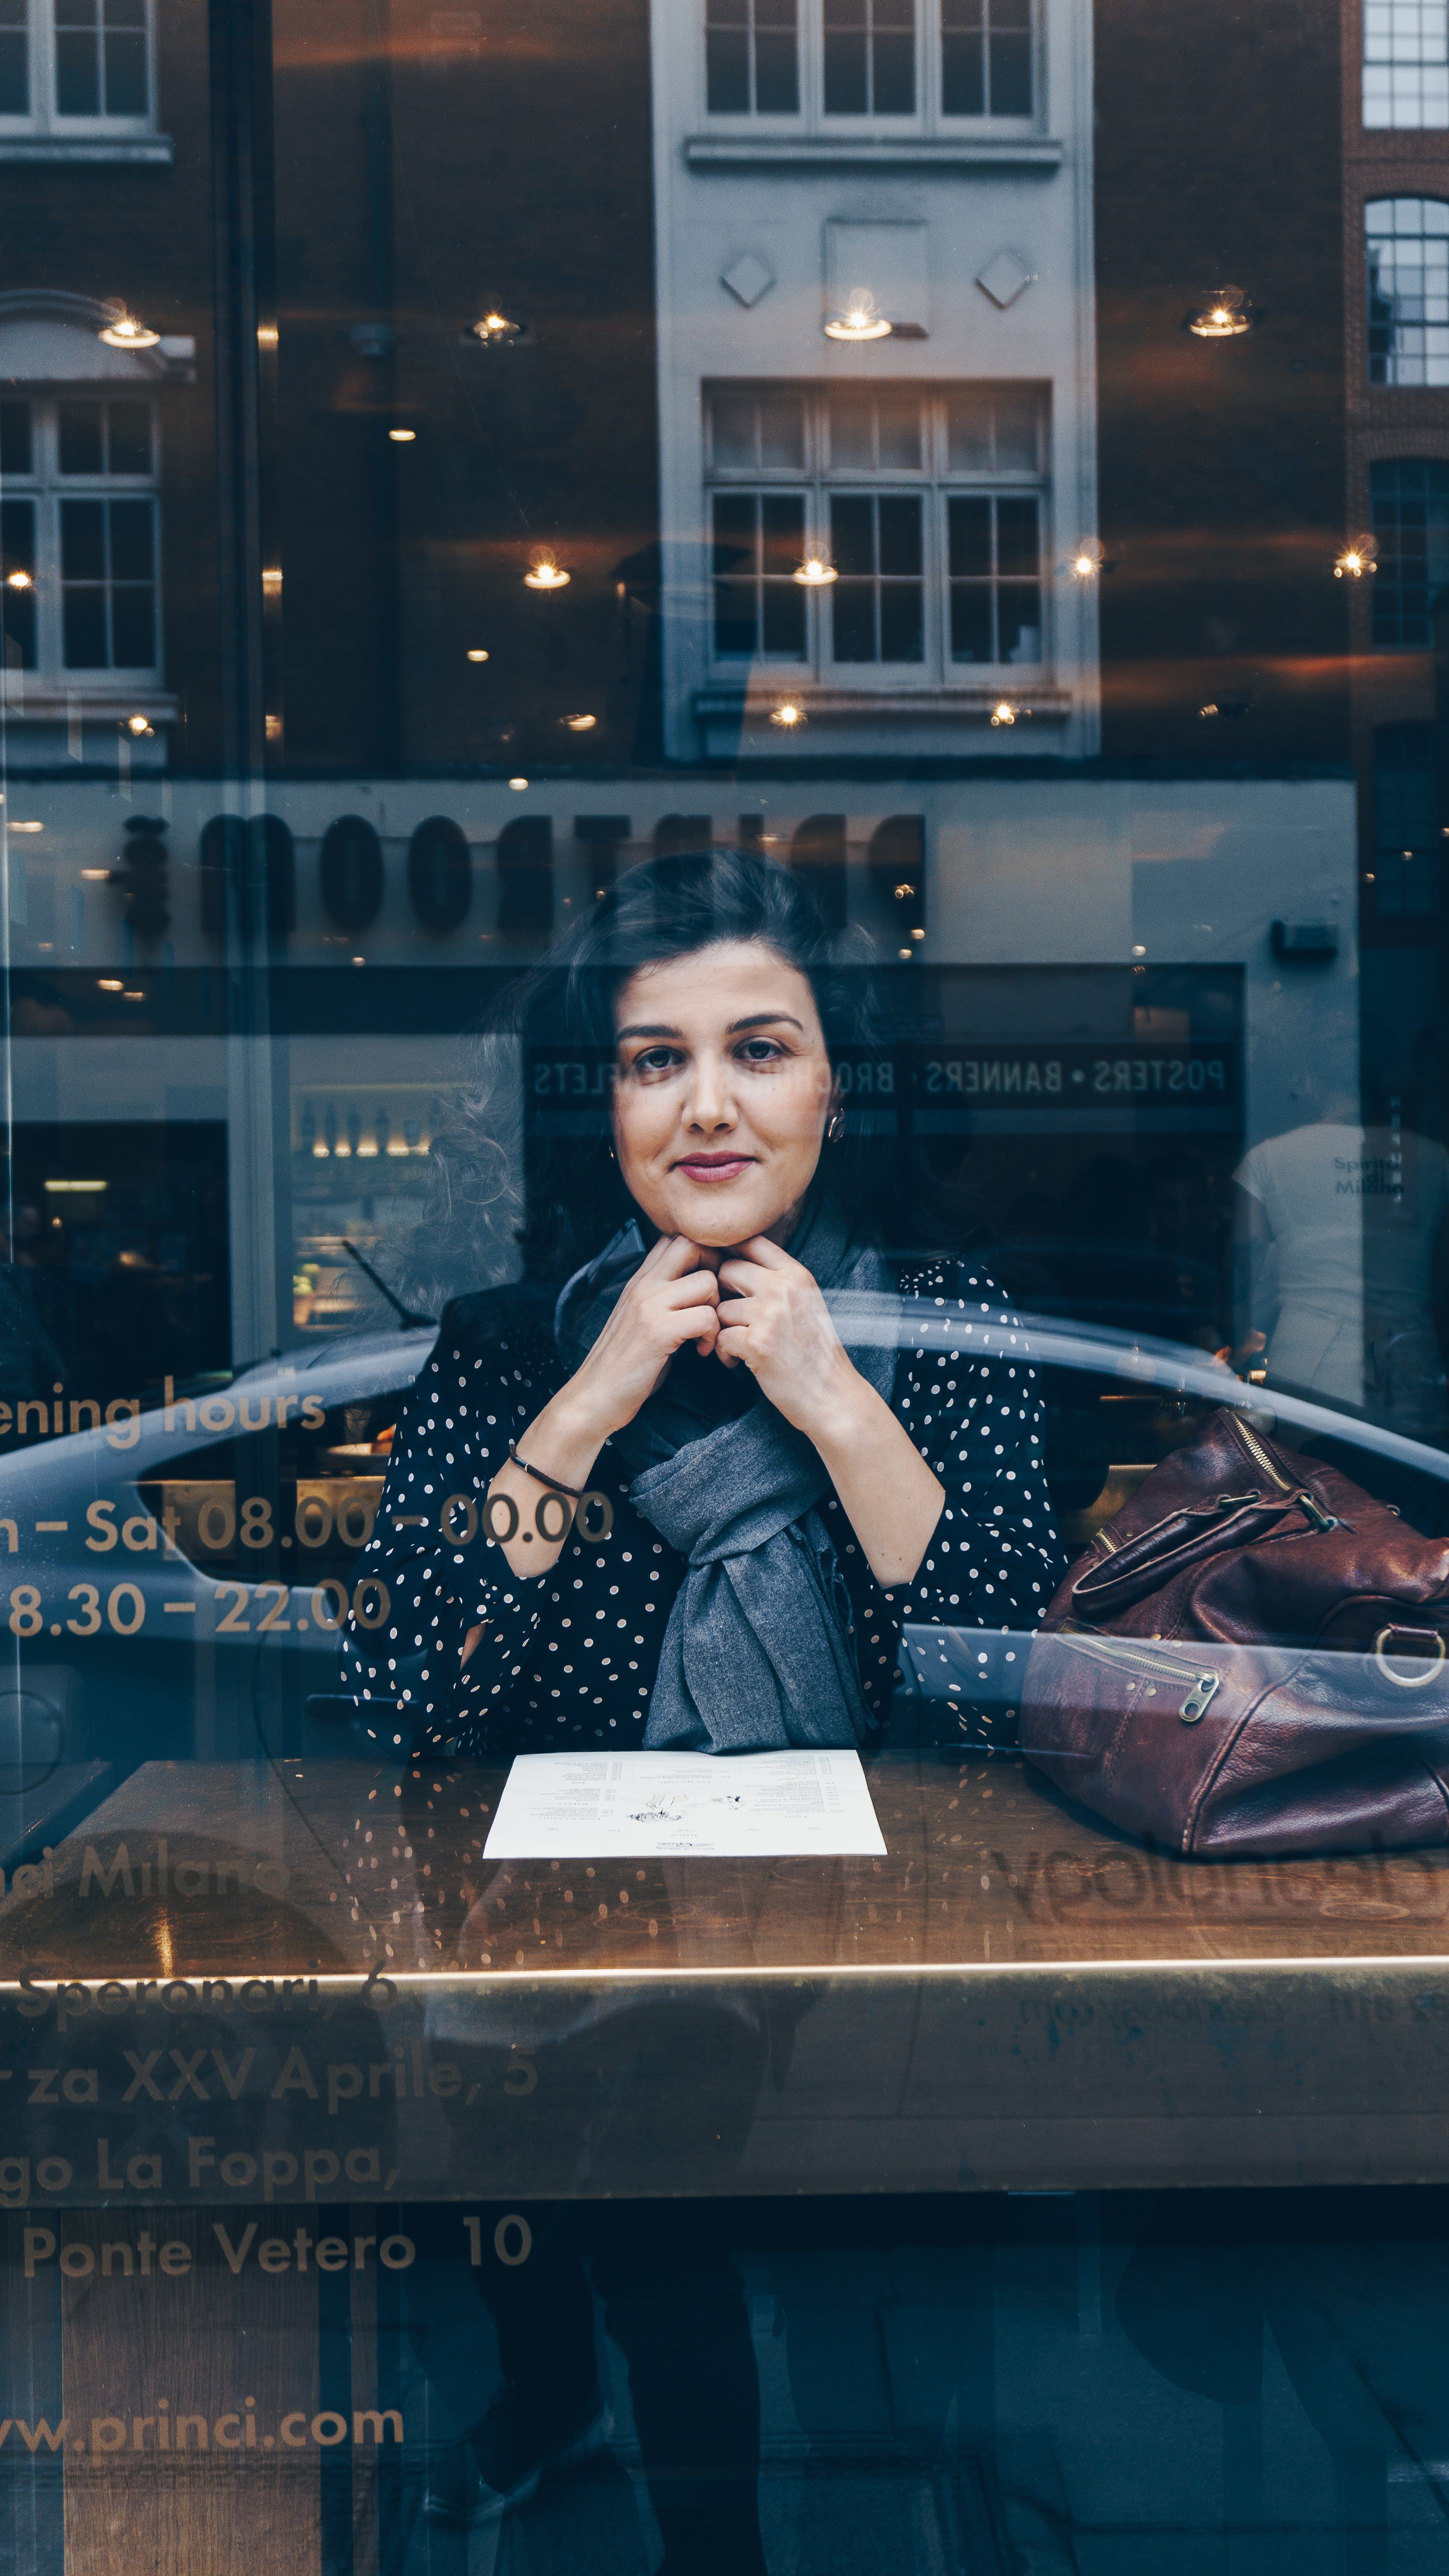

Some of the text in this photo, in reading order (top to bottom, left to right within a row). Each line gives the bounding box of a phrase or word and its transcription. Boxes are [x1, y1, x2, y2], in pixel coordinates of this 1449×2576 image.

[1336, 1179, 1405, 1194] Milano
[1368, 1170, 1385, 1182] di
[164, 1375, 326, 1433] hours
[85, 1500, 181, 1552] Sat
[197, 1496, 376, 1549] 08.00
[440, 1490, 614, 1546] 00.00
[9, 1583, 146, 1637] 8.30
[213, 1577, 391, 1632] 22.00
[0, 1839, 291, 1899] ci Milano
[361, 1959, 398, 2011] 6
[0, 2041, 538, 2114] za XXV Aprile, 5
[98, 2138, 163, 2190] La
[188, 2136, 399, 2202] Foppa,
[23, 2214, 532, 2278] Ponte Vetero 10
[0, 2396, 404, 2468] w.princi.com
